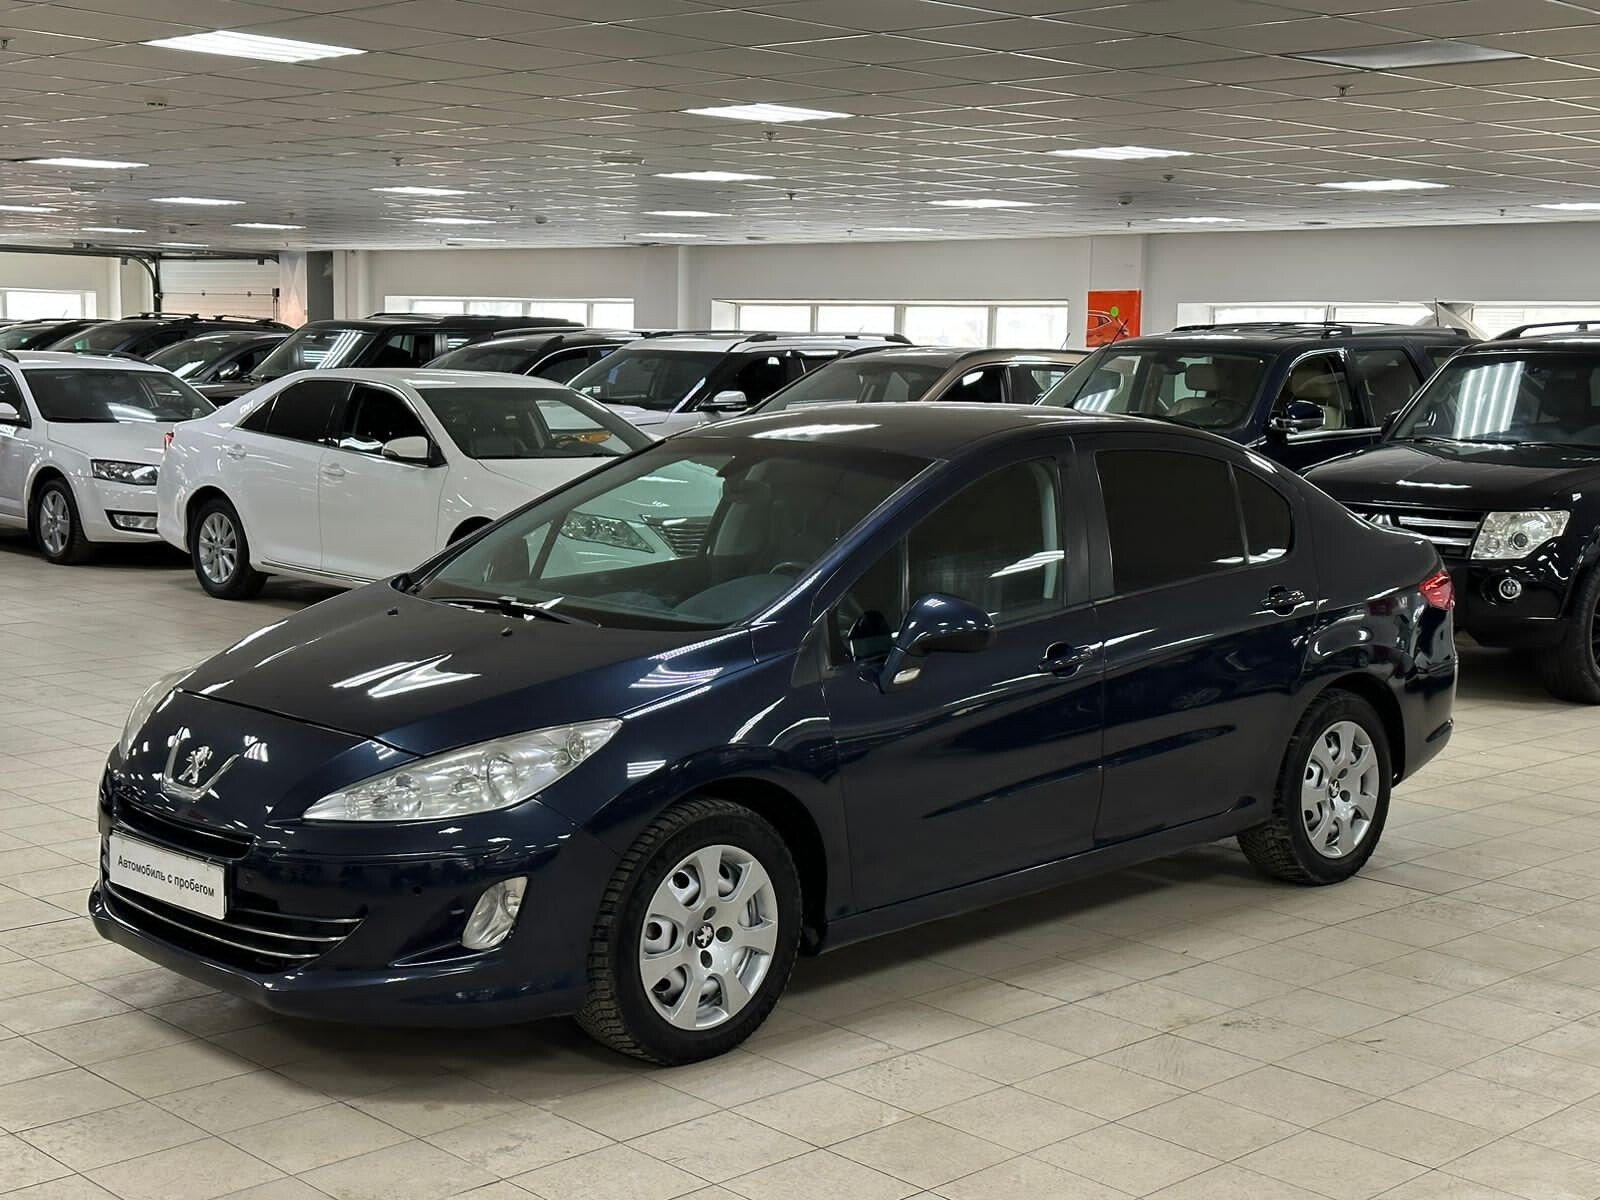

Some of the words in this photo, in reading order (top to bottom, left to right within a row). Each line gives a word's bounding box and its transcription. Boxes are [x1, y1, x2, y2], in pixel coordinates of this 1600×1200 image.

[118, 855, 165, 881] Автомобиль
[167, 874, 173, 884] с
[174, 876, 215, 897] пробегом
